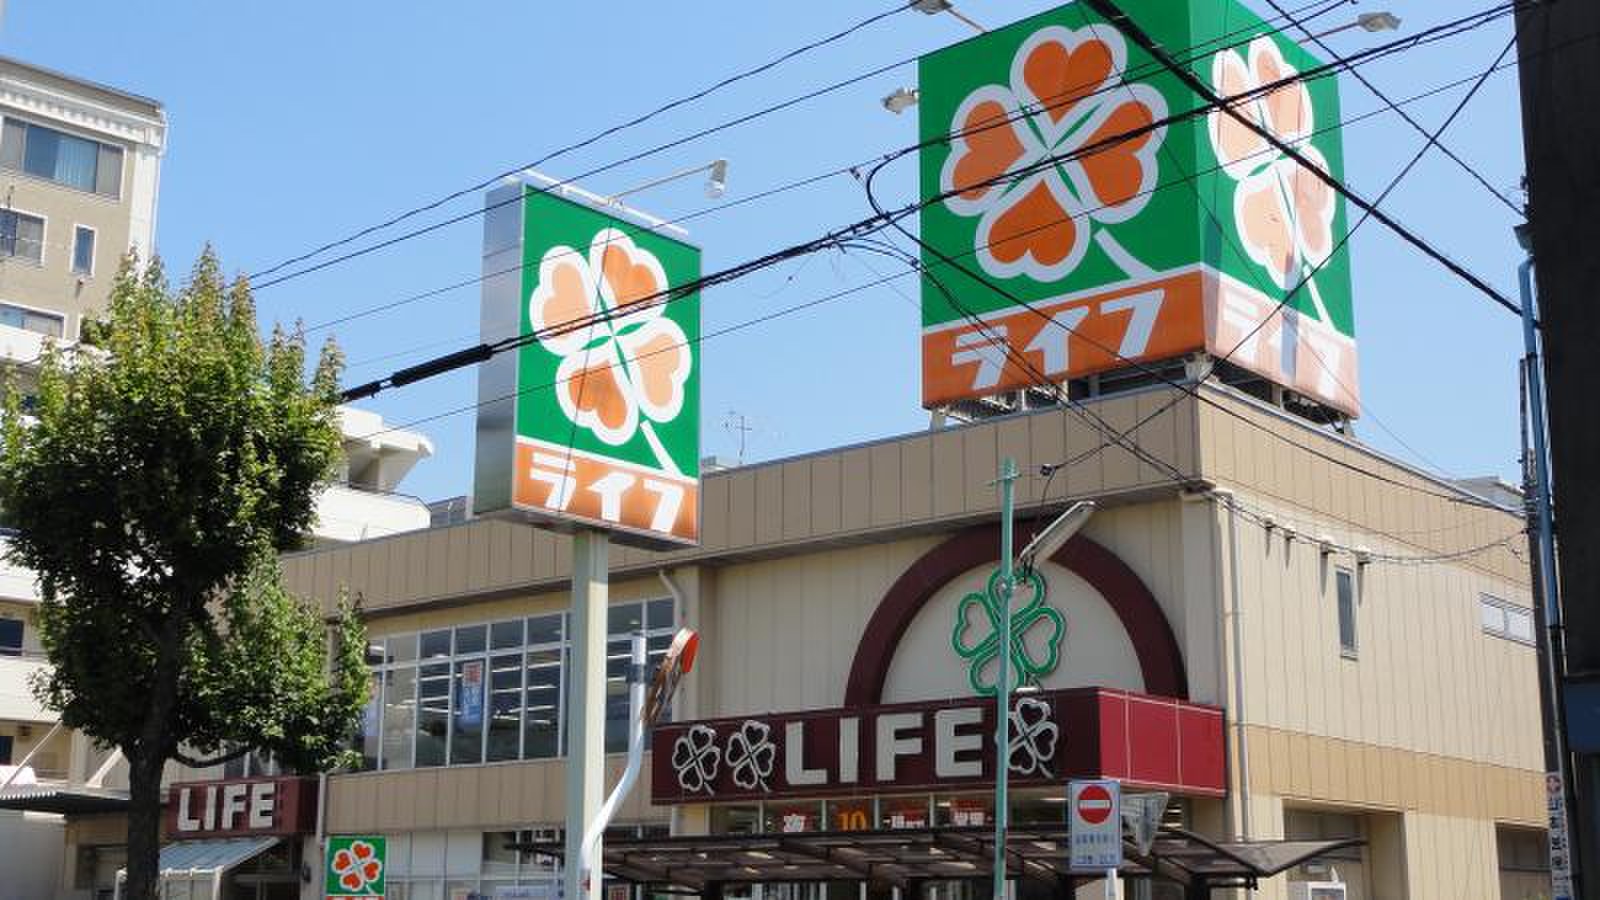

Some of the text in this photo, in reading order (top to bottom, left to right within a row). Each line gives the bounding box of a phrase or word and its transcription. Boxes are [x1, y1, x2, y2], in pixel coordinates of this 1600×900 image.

[951, 288, 1166, 390] ライフ
[530, 451, 684, 532] ライフ
[785, 707, 983, 784] LIFE
[177, 782, 274, 831] LIFE
